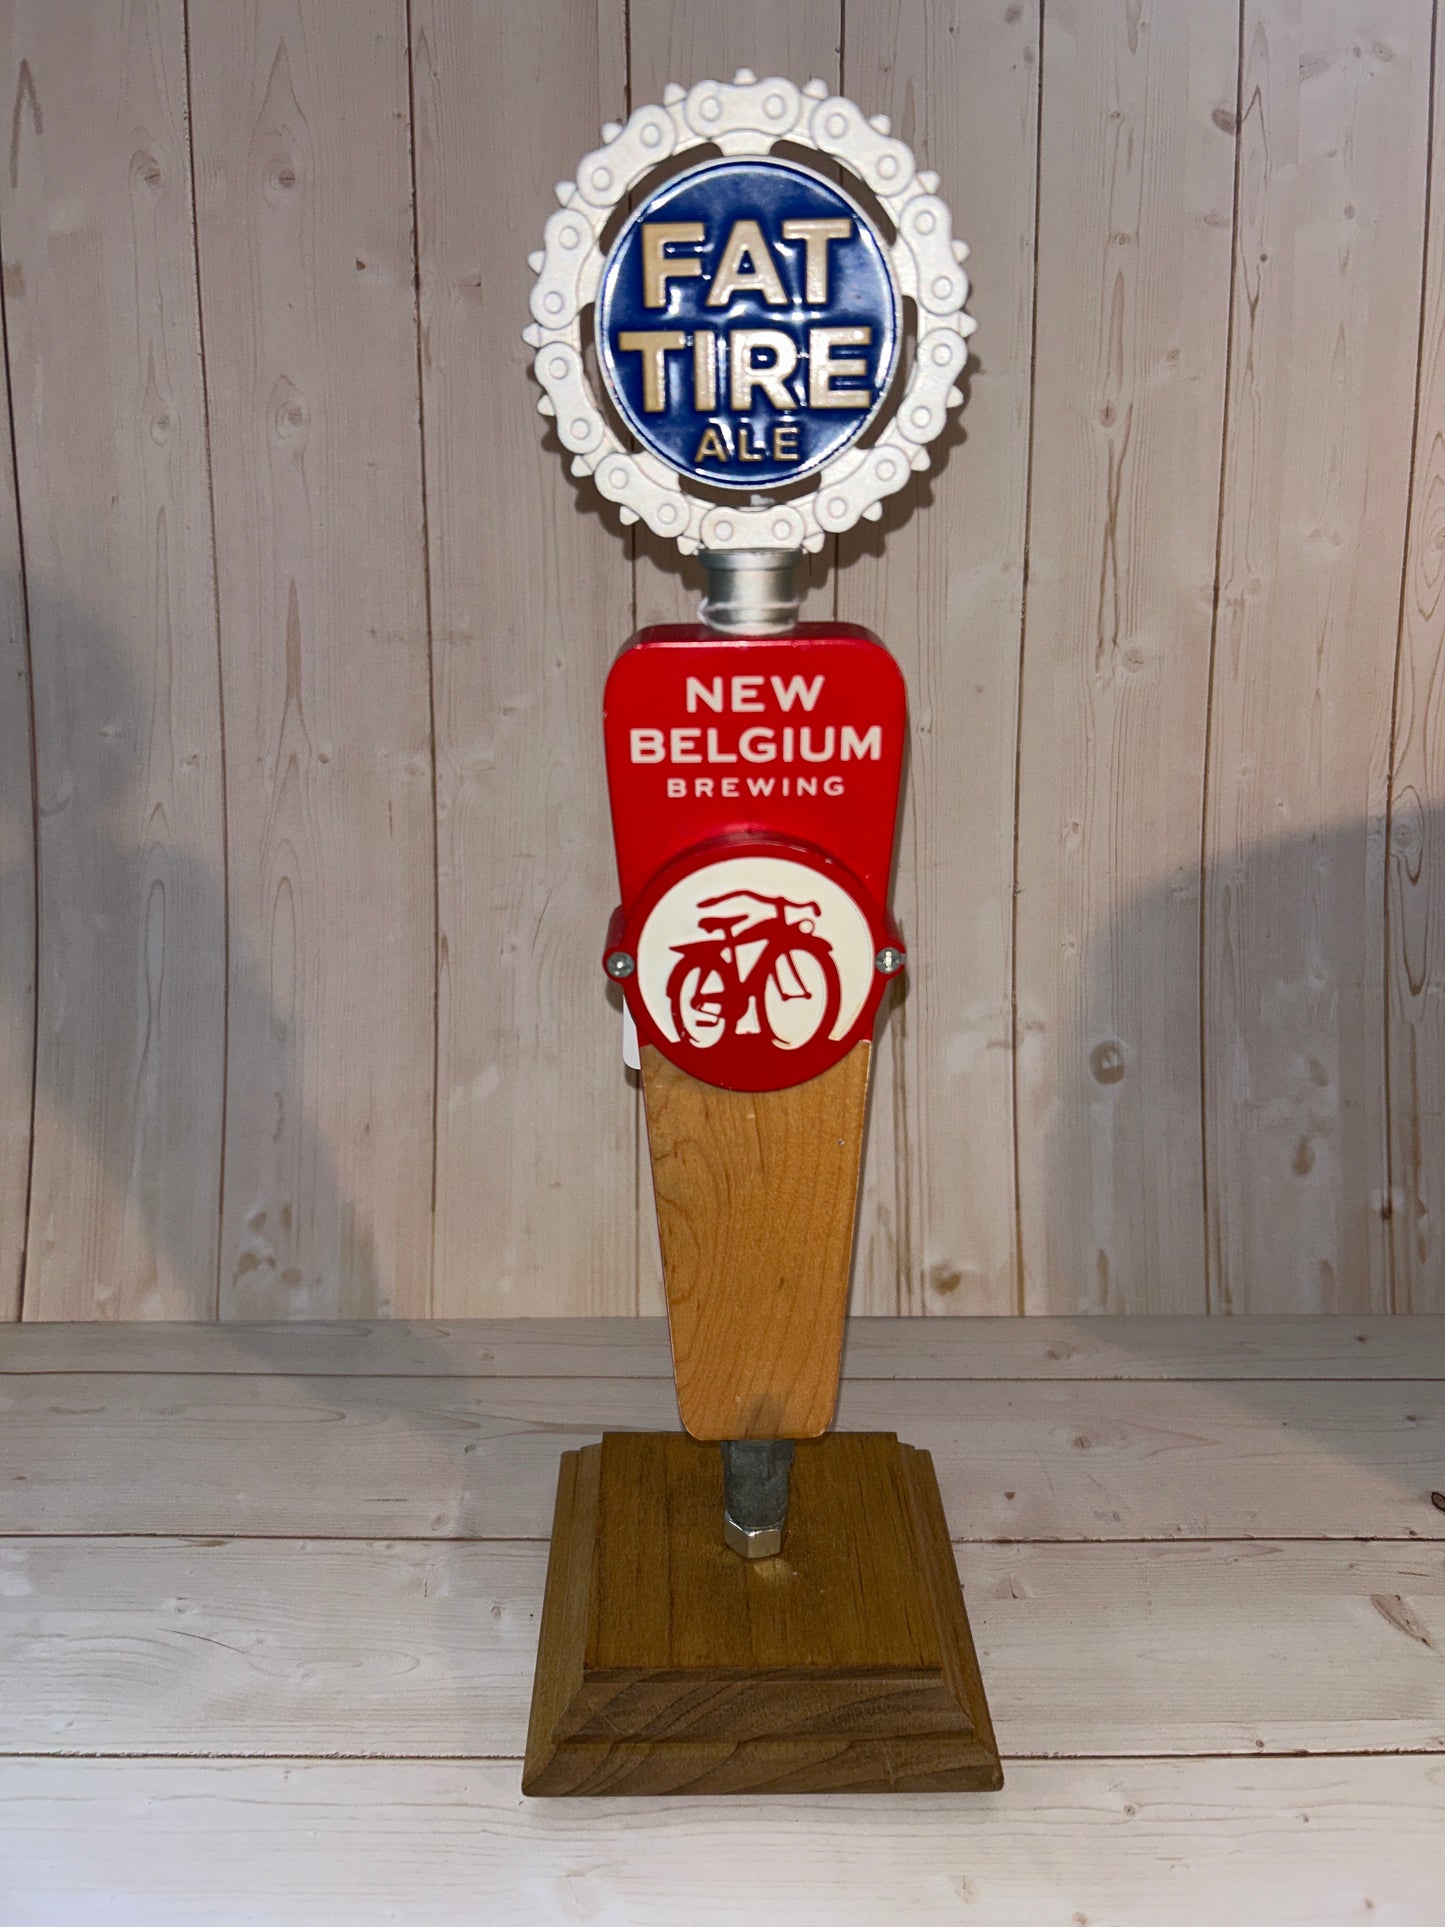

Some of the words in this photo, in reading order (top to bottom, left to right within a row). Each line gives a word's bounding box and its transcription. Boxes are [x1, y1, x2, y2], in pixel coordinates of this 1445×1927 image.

[641, 217, 852, 309] FAT
[618, 326, 873, 413] TIRE
[694, 426, 801, 463] ALE
[685, 674, 826, 713] NEW
[629, 725, 883, 764] BELGIUM
[666, 776, 846, 799] BREWING
